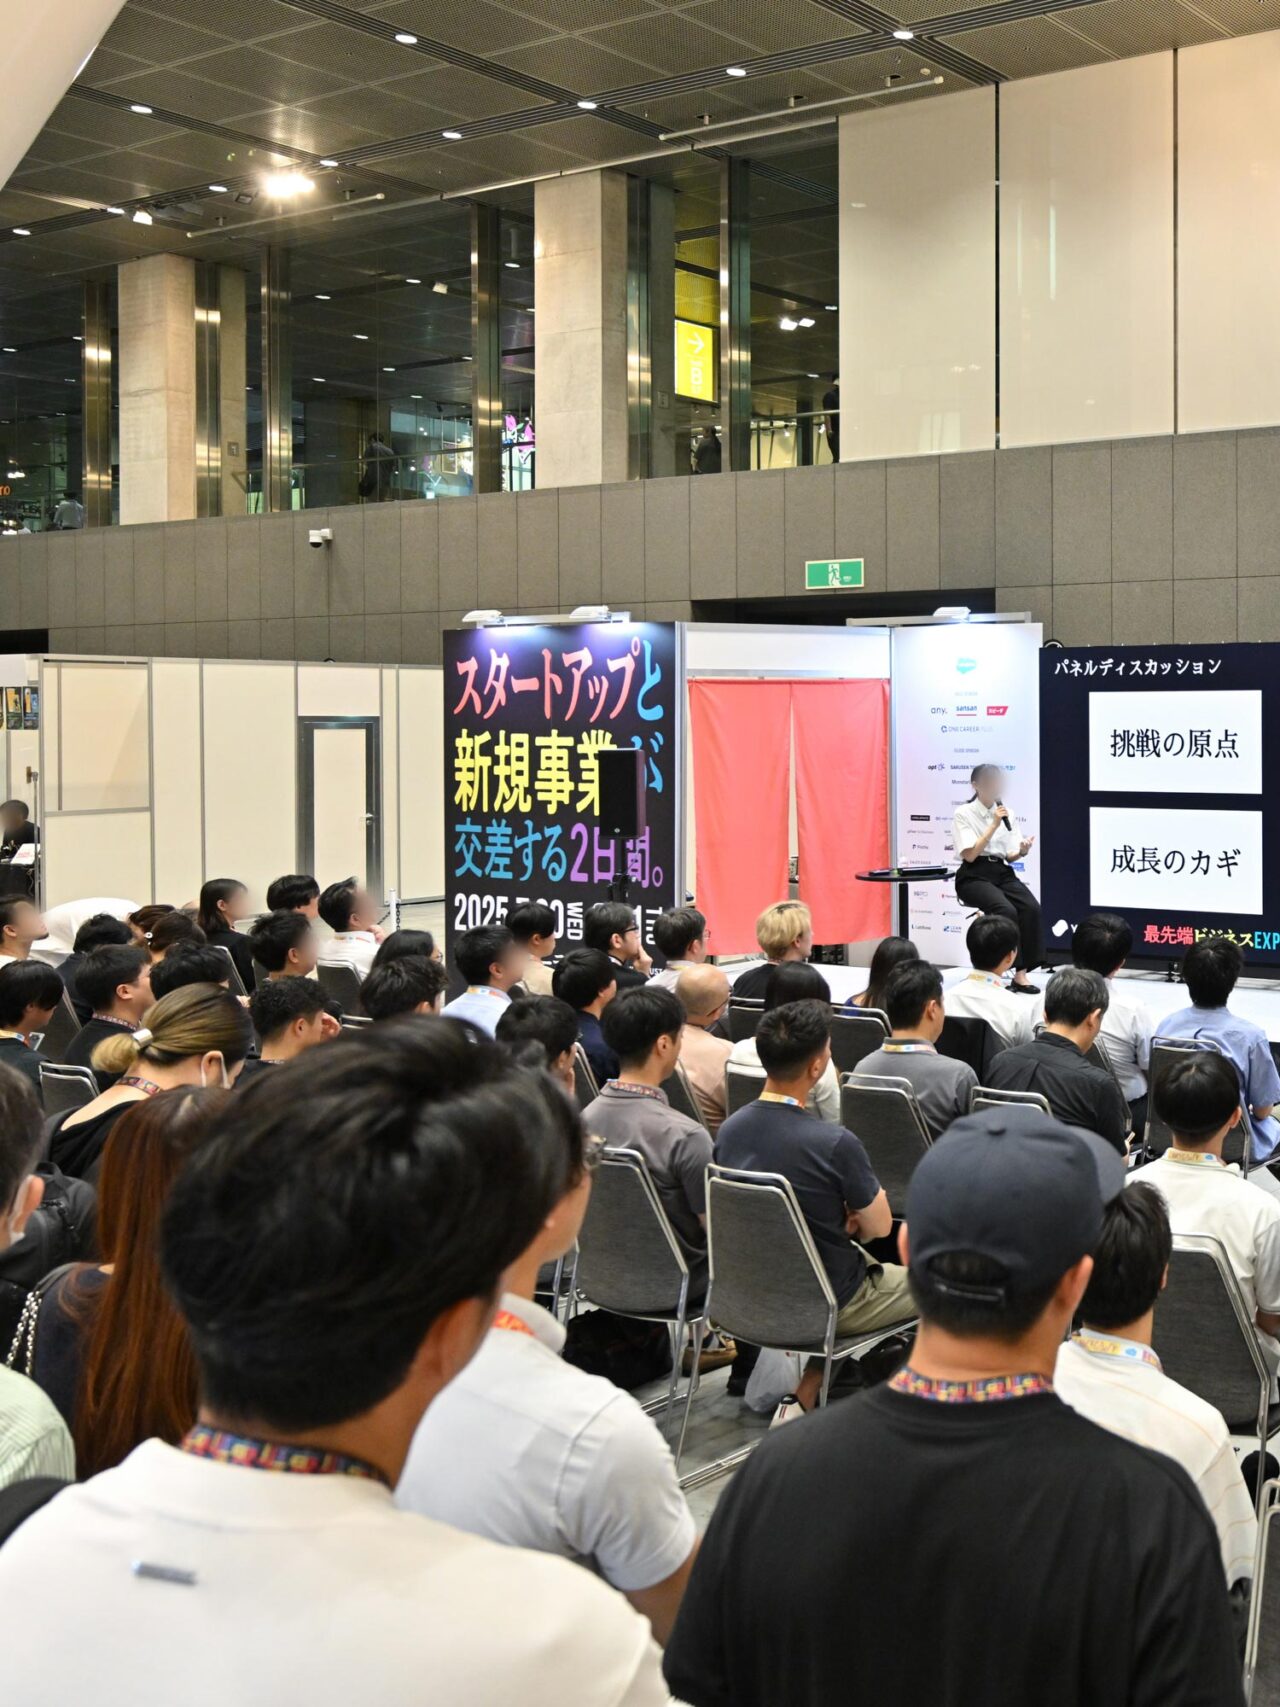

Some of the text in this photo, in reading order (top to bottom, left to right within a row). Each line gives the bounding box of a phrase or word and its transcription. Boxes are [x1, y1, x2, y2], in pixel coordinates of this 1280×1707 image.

[453, 636, 664, 722] スタートアップと
[1054, 658, 1222, 678] パネルディスカッション
[1110, 728, 1240, 760] 挑戦の原点
[1110, 845, 1241, 878] 成長のカギ
[567, 902, 583, 941] WED
